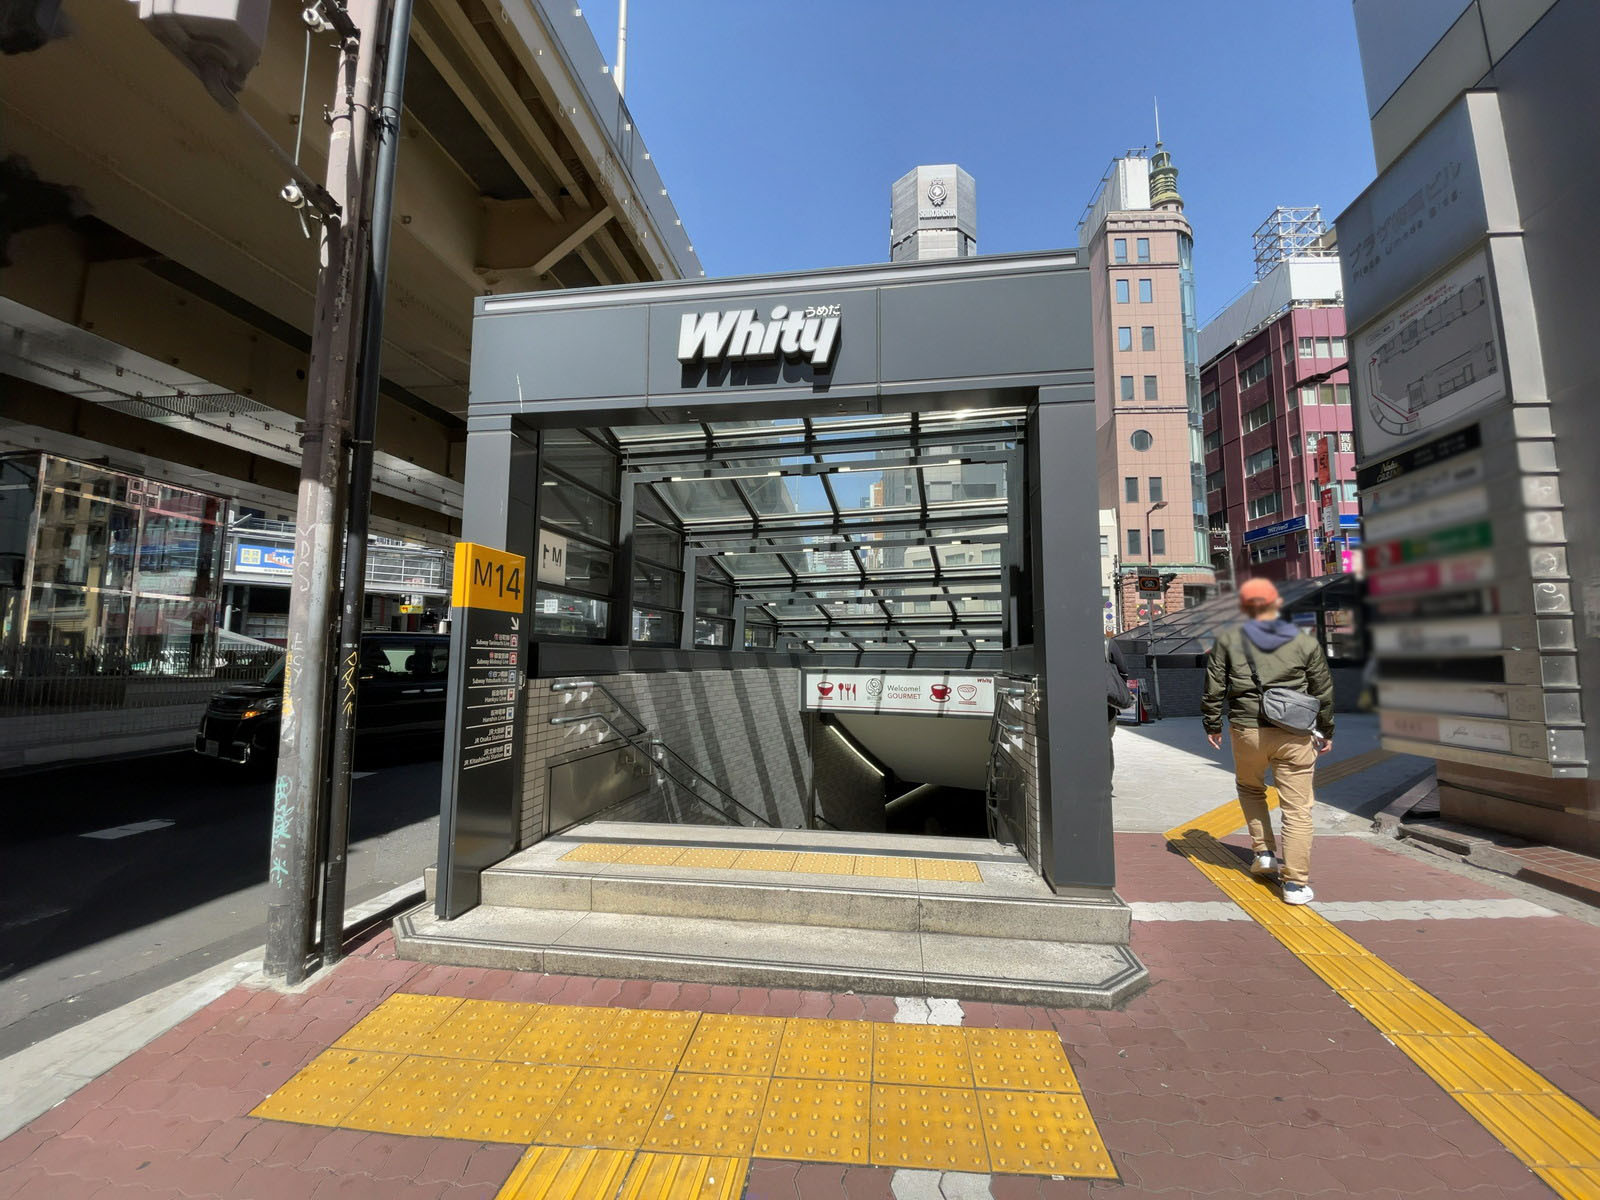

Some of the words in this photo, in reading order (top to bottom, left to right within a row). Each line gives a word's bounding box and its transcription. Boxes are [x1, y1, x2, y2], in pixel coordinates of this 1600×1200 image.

[804, 303, 841, 317] うめだ
[677, 305, 841, 366] Whity
[264, 552, 290, 565] Link
[473, 558, 521, 600] M14
[887, 684, 921, 692] Welcome!
[887, 692, 921, 700] GOURMET
